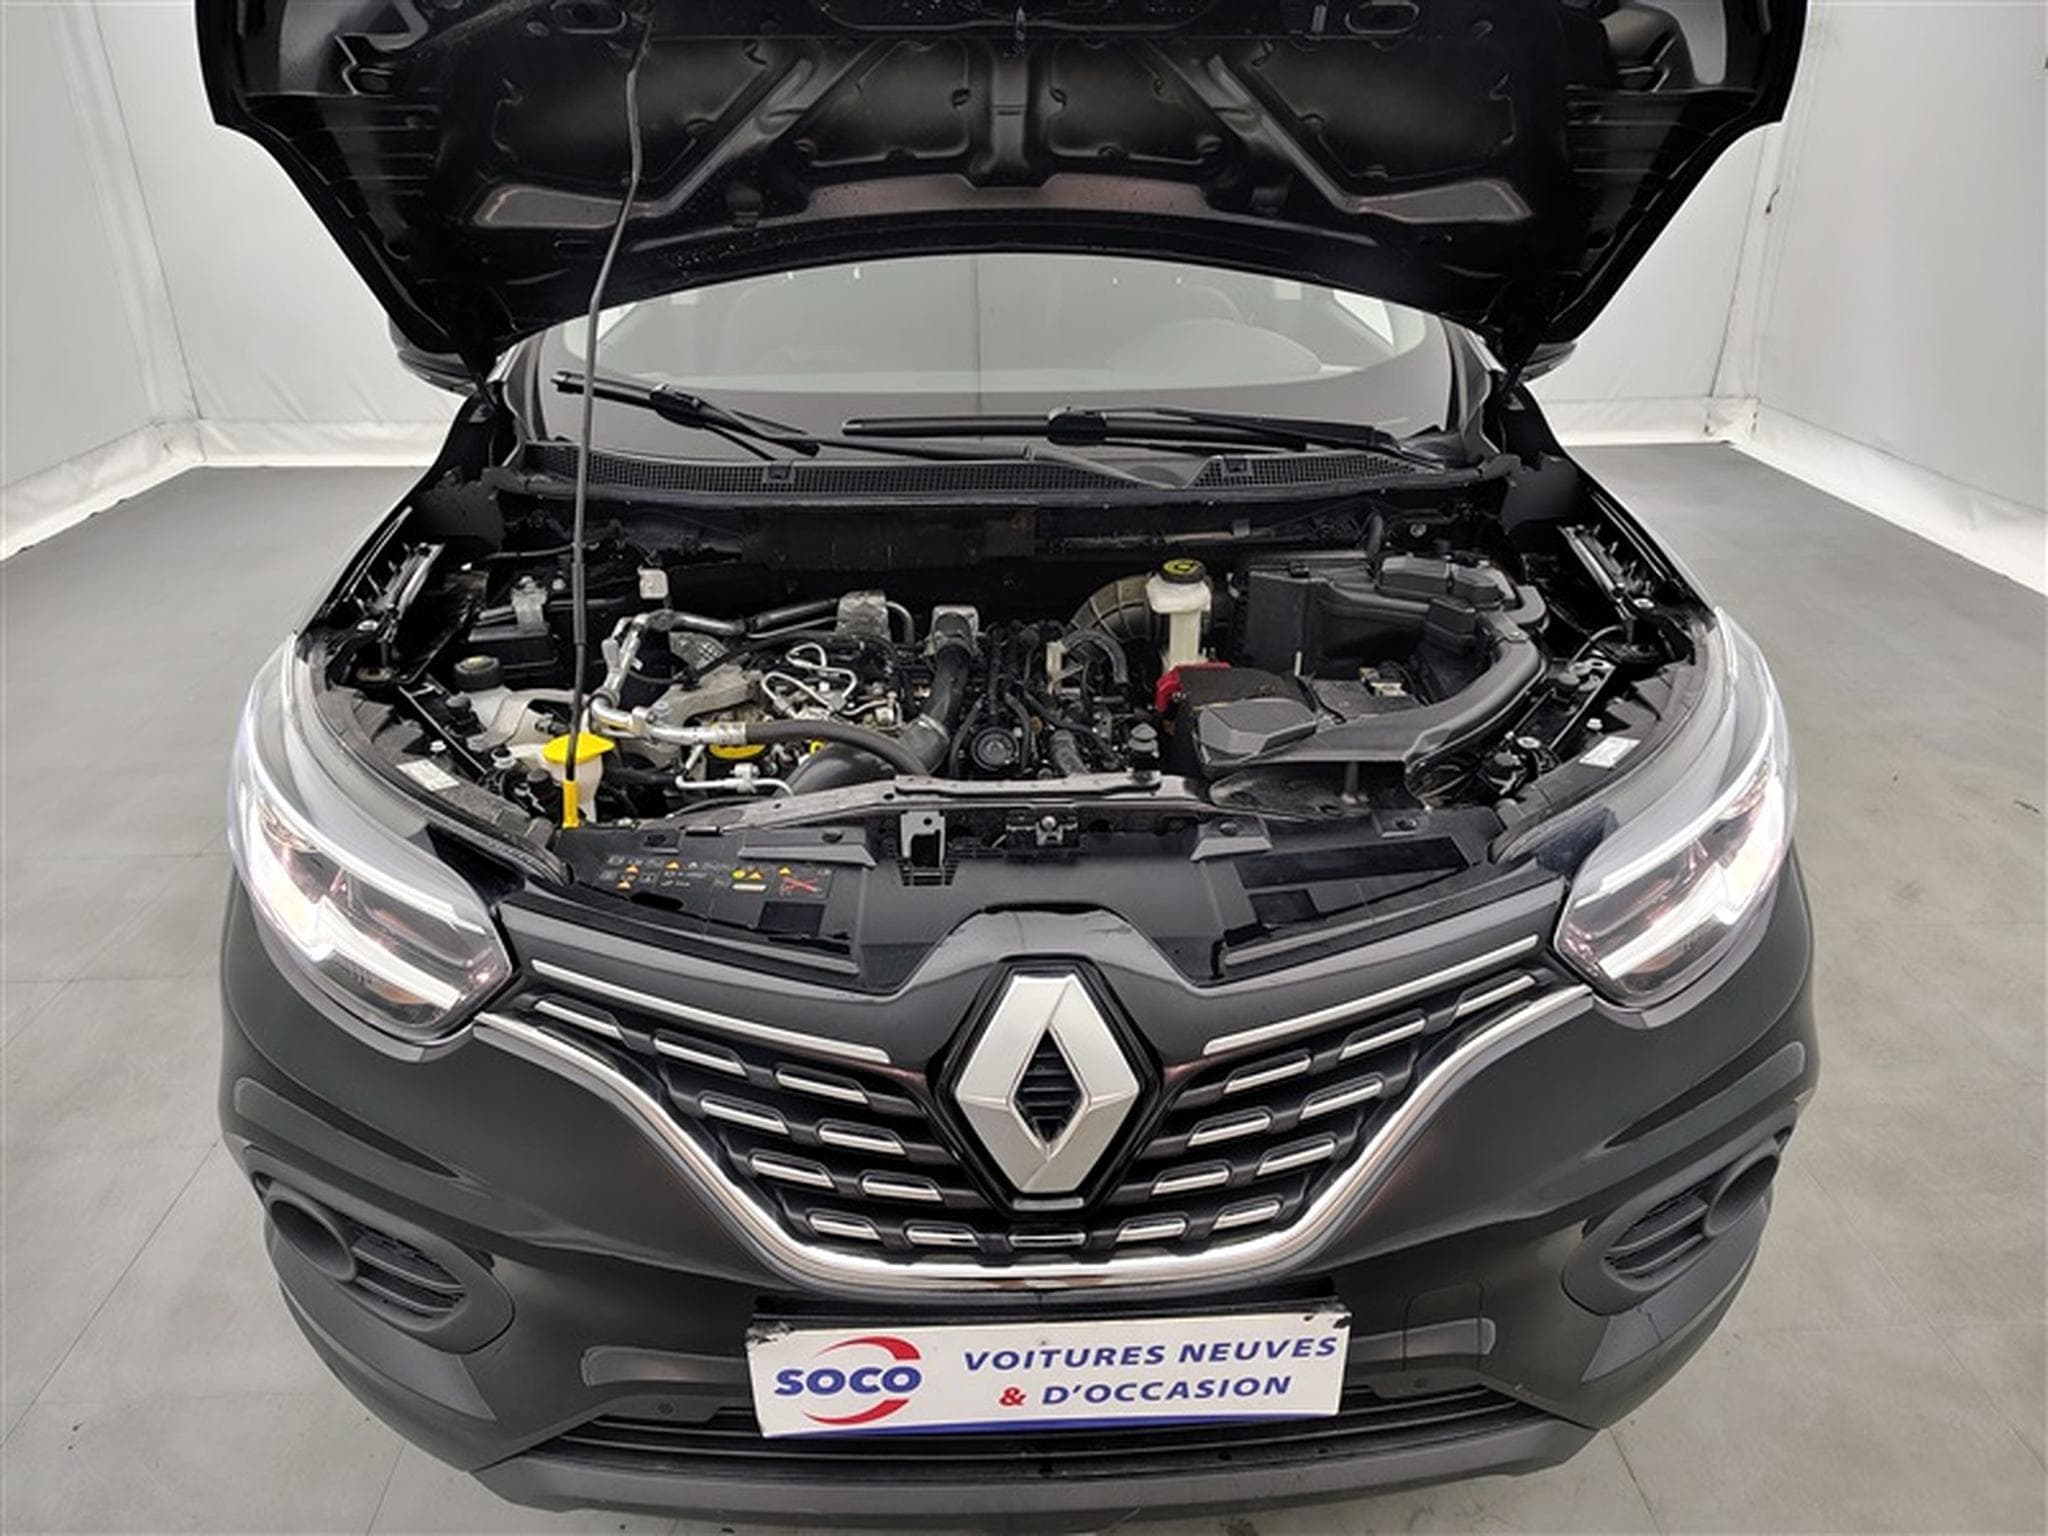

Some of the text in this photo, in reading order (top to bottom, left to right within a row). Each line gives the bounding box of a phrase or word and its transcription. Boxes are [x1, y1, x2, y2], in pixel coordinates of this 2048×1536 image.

[963, 1336, 1338, 1371] VOITURES NEUVES
[774, 1365, 922, 1396] SOCO
[998, 1376, 1292, 1406] & D'OCCASION
